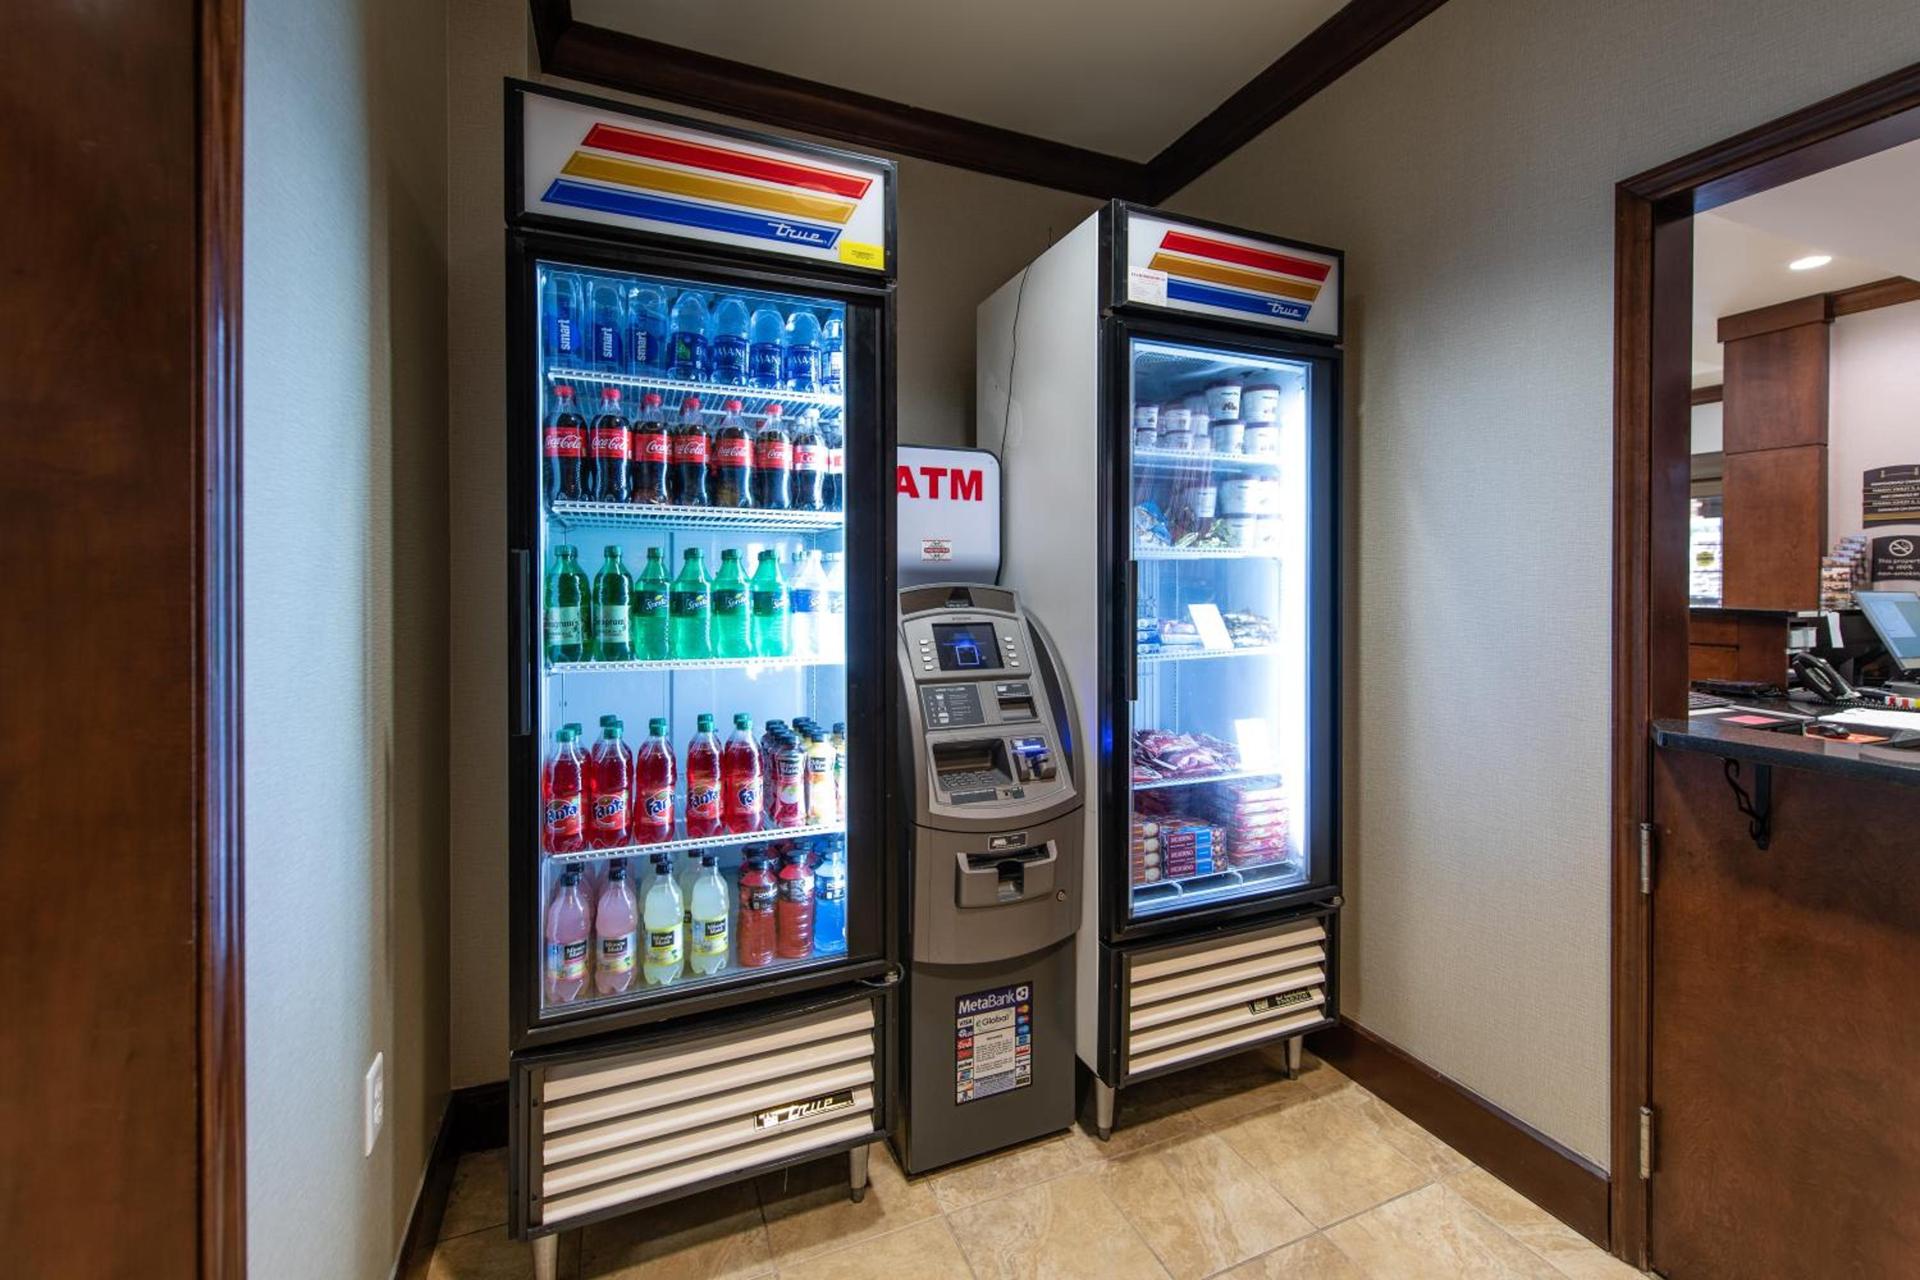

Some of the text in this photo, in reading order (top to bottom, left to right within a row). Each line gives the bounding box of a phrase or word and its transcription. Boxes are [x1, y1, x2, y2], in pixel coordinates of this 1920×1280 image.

[601, 327, 613, 359] smart
[636, 331, 648, 362] smart
[896, 465, 983, 502] ATM
[1893, 558, 1920, 566] propert
[958, 989, 1015, 1015] MetaBank
